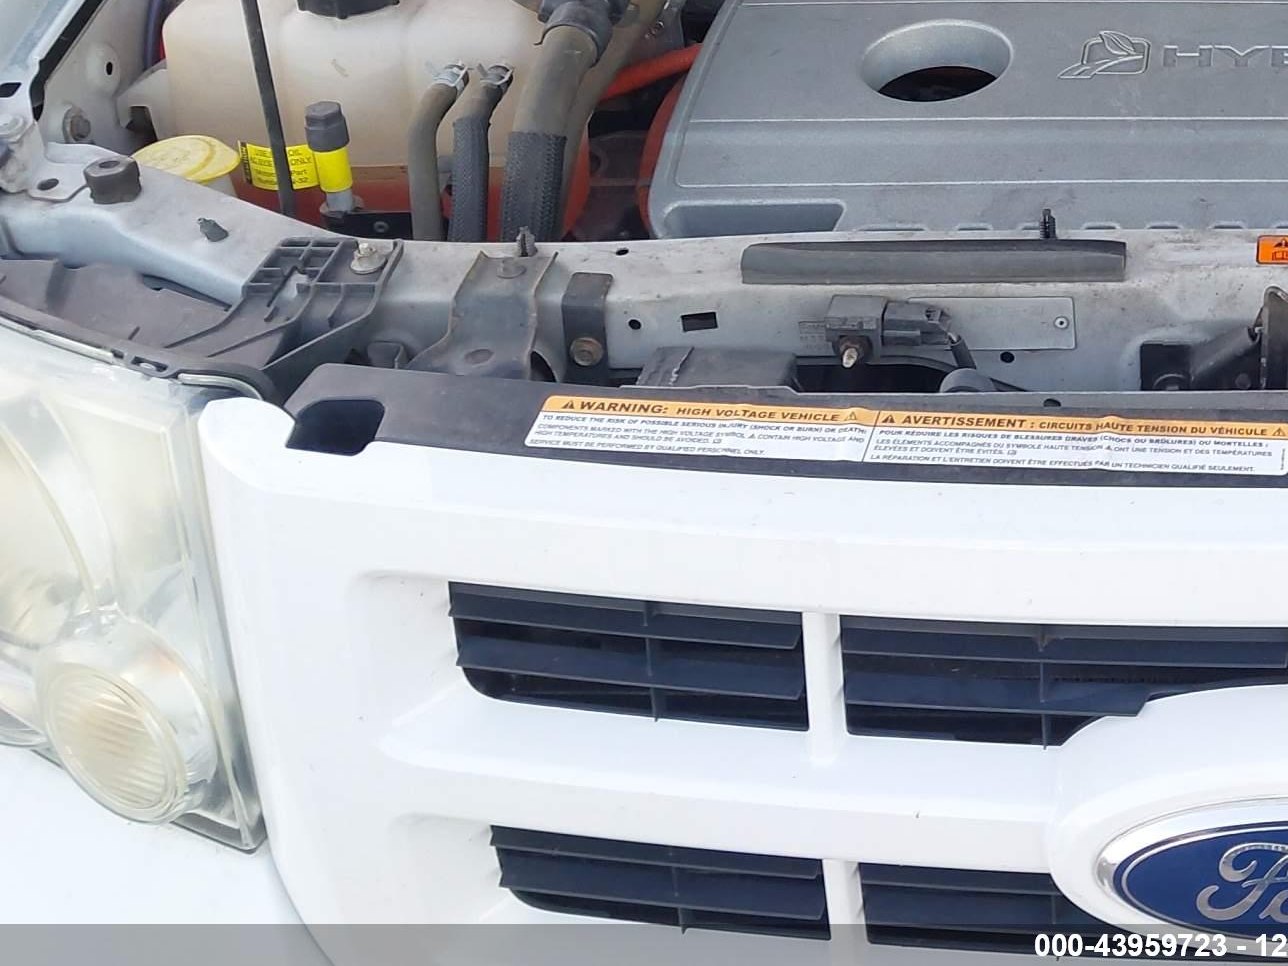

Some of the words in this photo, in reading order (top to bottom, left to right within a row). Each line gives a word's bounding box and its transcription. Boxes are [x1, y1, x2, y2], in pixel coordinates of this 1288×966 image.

[580, 401, 669, 414] WARNING:
[676, 408, 710, 416] HIGH
[716, 410, 776, 419] VOLTAGE
[781, 412, 840, 422] VEHICLE
[902, 415, 1026, 428] AVERTISSEMENT
[1040, 421, 1092, 430] CIRCUITS
[1096, 422, 1134, 432] HAUTE
[1137, 424, 1187, 434] TENSION
[1190, 426, 1207, 434] DU
[1210, 426, 1268, 436] VÉHICULE
